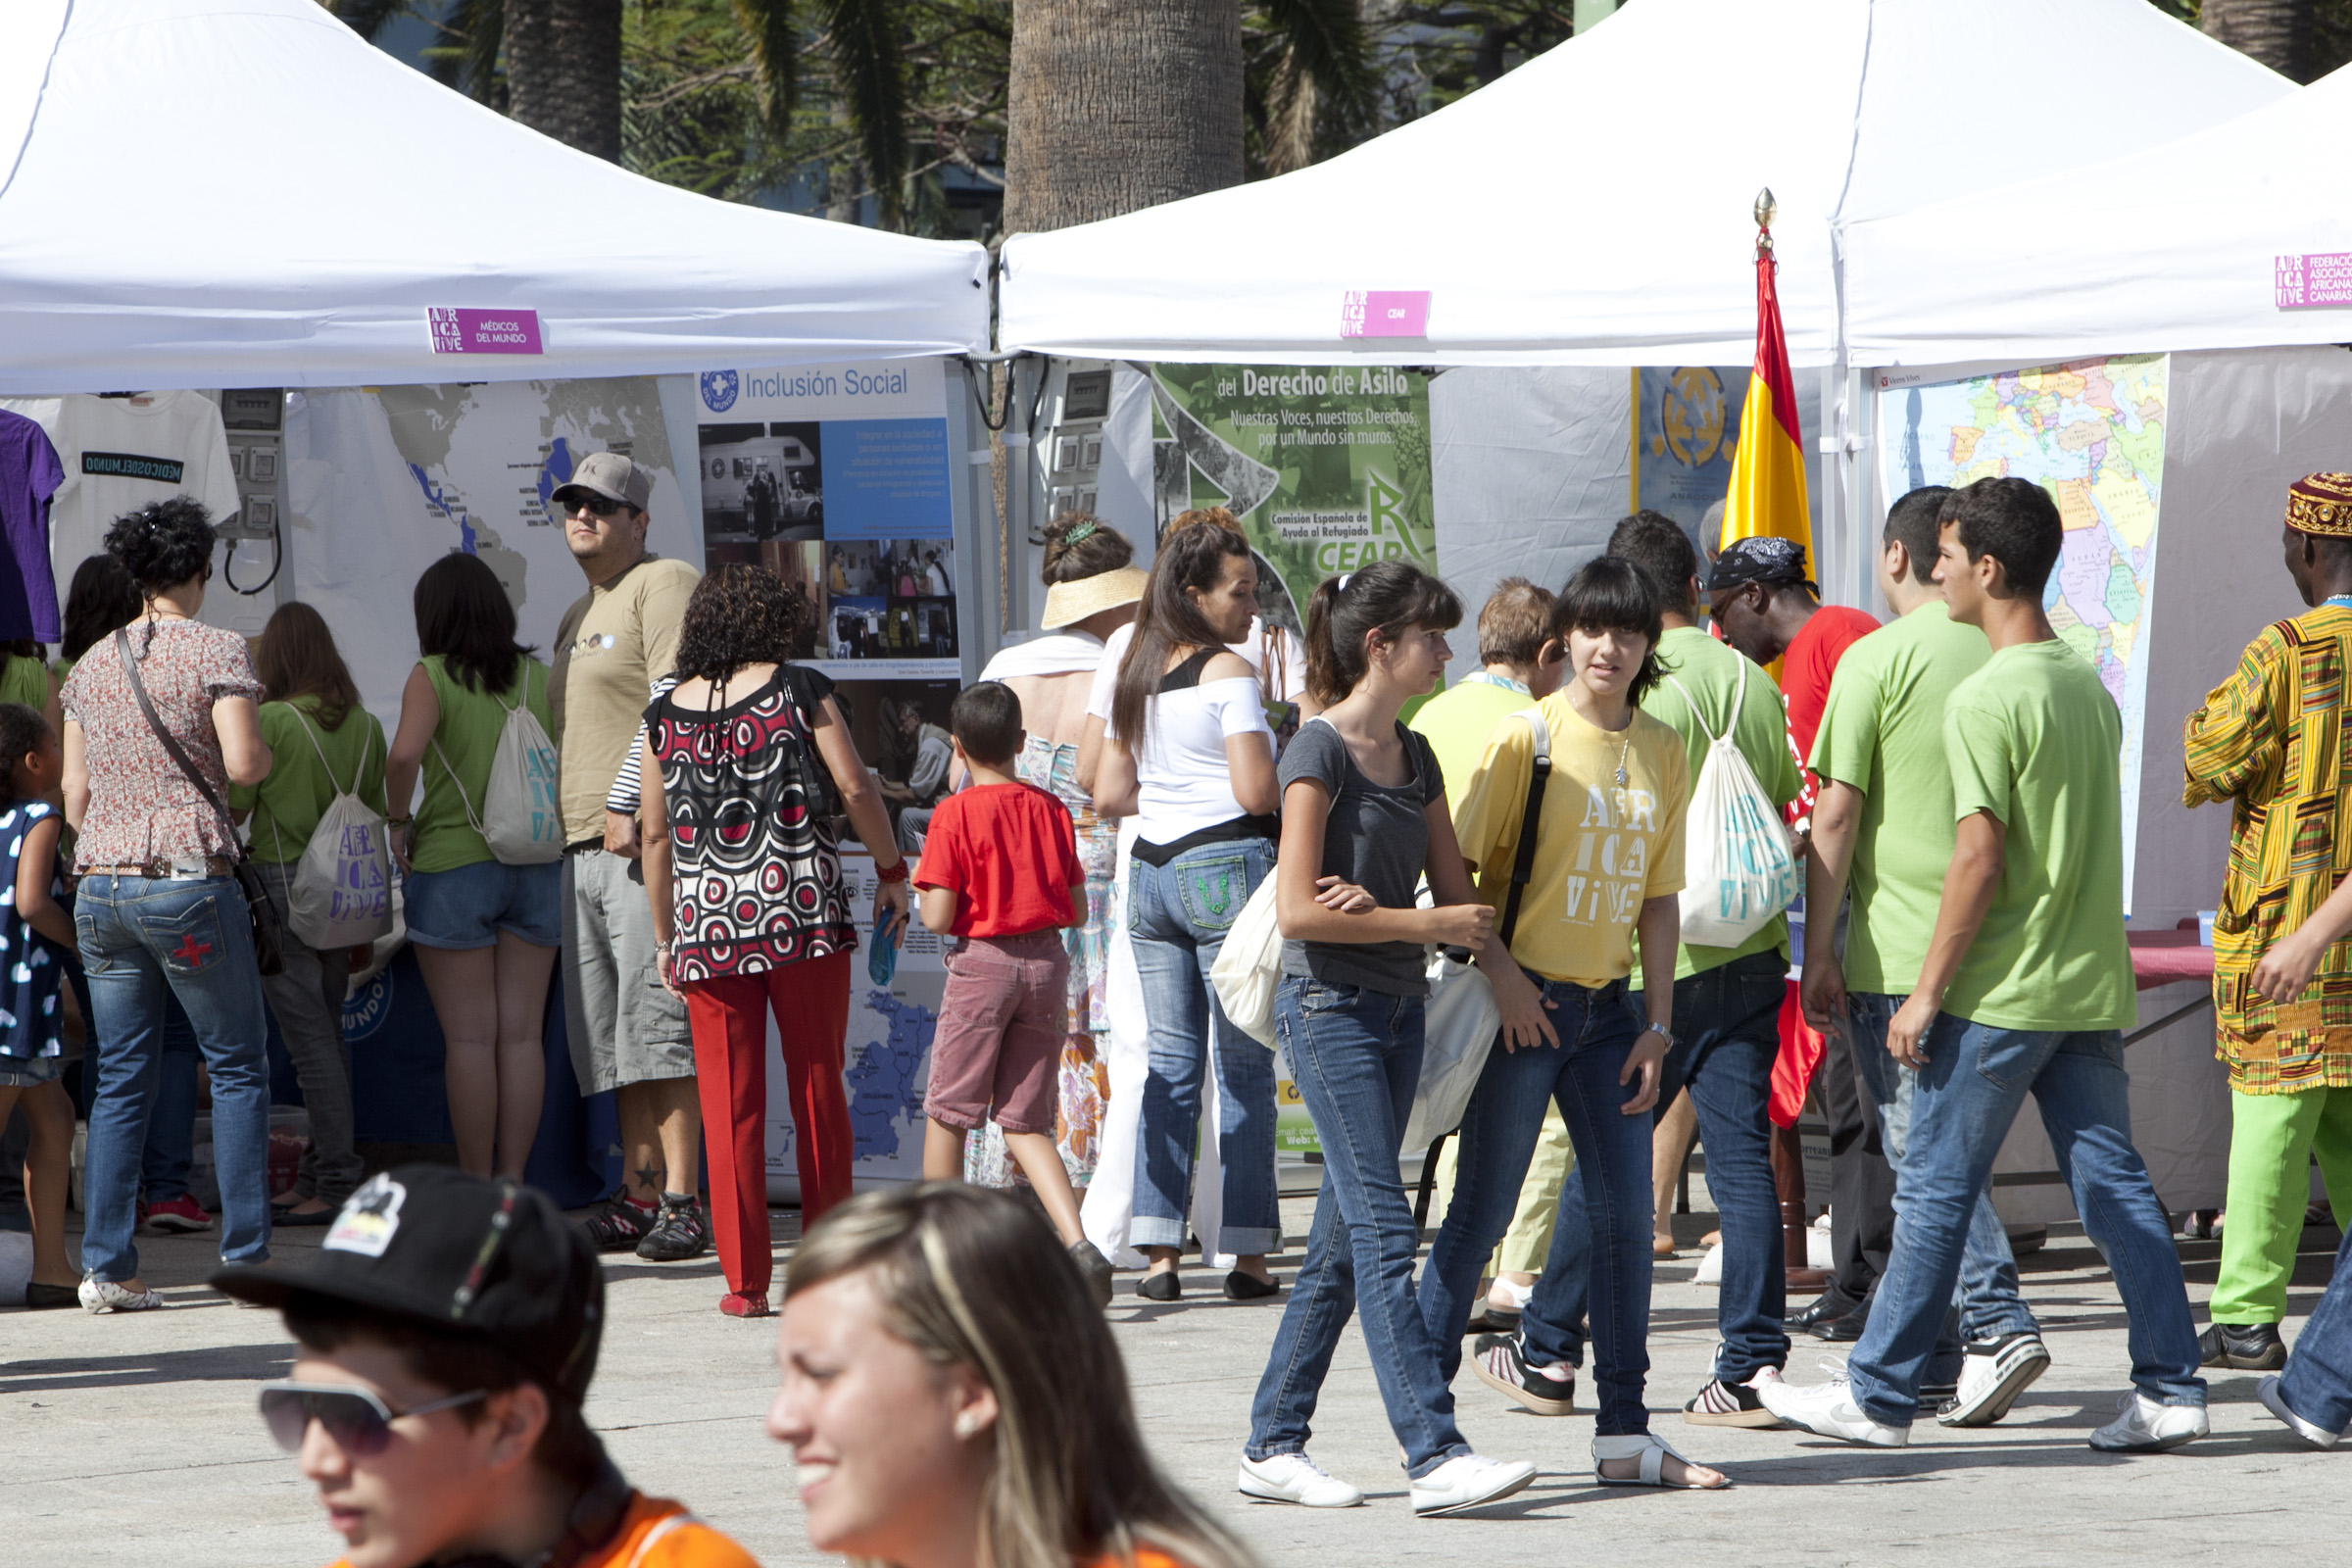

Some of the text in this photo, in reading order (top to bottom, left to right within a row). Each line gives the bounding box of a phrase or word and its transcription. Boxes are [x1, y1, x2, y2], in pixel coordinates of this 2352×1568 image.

[2277, 270, 2304, 287] ICA
[2310, 289, 2352, 302] CANARIAS
[1387, 308, 1406, 318] CEAR
[432, 322, 461, 336] ICA
[480, 319, 519, 331] MÉDICOS
[476, 333, 526, 343] DEL MUNDO
[746, 368, 906, 398] Inclusión Social
[1218, 367, 1408, 397] del Derecho de Asilo
[701, 387, 736, 411] DEL MUNDO
[1230, 407, 1418, 428] Nuestras Voces, nuestros Derechos,
[1258, 428, 1396, 450] por un Mundo sin muros.
[1271, 512, 1368, 525] Comisión Española de
[1282, 525, 1369, 540] Ayuda al Refugiado
[1580, 785, 1656, 833] AFR
[339, 823, 376, 857] AFR
[1574, 832, 1646, 878] ICA
[337, 858, 384, 890] ICA
[1286, 1136, 1310, 1146] Web:
